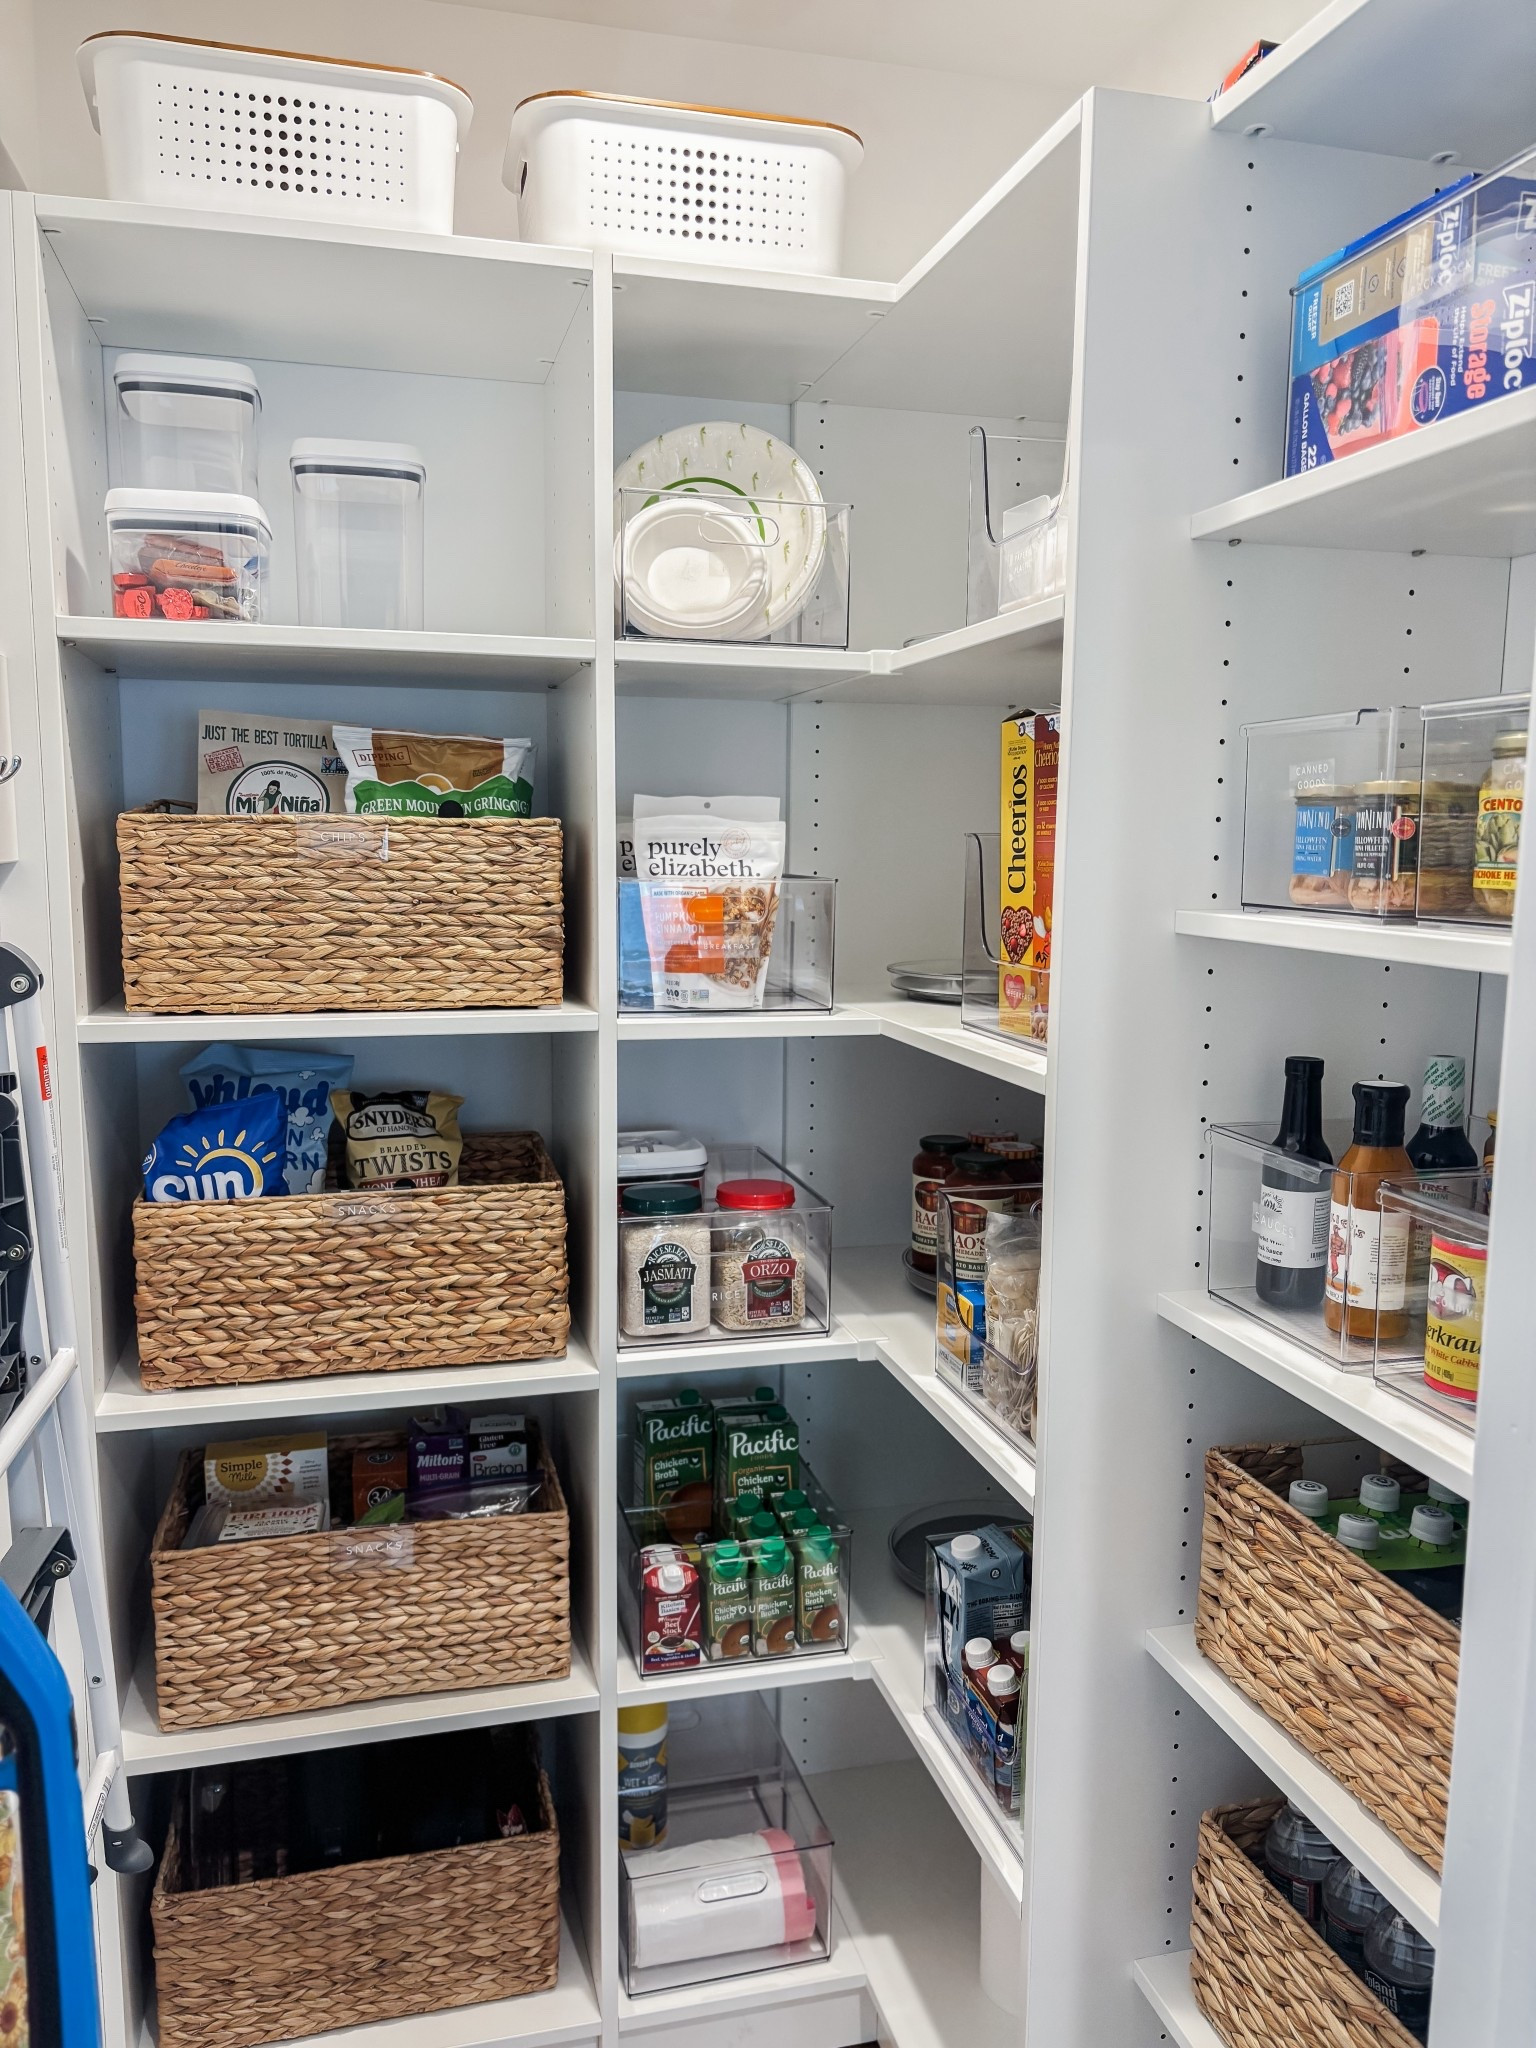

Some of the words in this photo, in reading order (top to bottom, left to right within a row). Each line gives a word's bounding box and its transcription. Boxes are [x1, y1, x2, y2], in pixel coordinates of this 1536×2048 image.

[1436, 204, 1460, 286] Ziploc
[1310, 291, 1319, 341] FREEZER
[1459, 306, 1467, 336] Helps
[1500, 287, 1531, 390] Ziploc
[1458, 337, 1467, 373] Extend
[1463, 299, 1496, 399] Storage
[1301, 392, 1310, 440] GALLON
[1307, 445, 1317, 469] 22
[202, 724, 227, 741] JUST
[231, 727, 250, 743] THE
[254, 729, 279, 745] BEST
[283, 732, 328, 750] TORTILLA
[358, 751, 405, 762] DIPPING
[1295, 763, 1329, 777] CANNED
[1297, 778, 1326, 790] GOODS
[235, 796, 257, 814] Mi
[280, 795, 320, 813] Niña
[360, 798, 403, 815] GREEN
[406, 799, 472, 815] MOUNN
[474, 796, 518, 812] GRINGO
[1483, 798, 1523, 812] CENTO
[1008, 764, 1028, 894] Cheerios
[320, 832, 366, 844] CHIPS
[648, 837, 722, 861] purely
[648, 858, 761, 877] elizabeth.
[655, 911, 696, 923] PUMPKIN
[657, 923, 705, 934] CINNAMON
[703, 942, 756, 950] BREAKFAST
[353, 1110, 434, 1130] SNYDER'S
[380, 1143, 427, 1154] BRAIDED
[354, 1150, 452, 1179] TWISTS
[337, 1203, 397, 1217] SNACKS
[1254, 1211, 1294, 1239] SAUCES
[915, 1235, 934, 1245] TOMATO
[955, 1234, 986, 1251] AO'S
[647, 1244, 689, 1264] RICESELECT
[643, 1267, 693, 1283] JASMATI
[750, 1262, 790, 1278] ORZO
[711, 1290, 741, 1302] RICE
[1434, 1298, 1485, 1323] CONDIME
[1430, 1347, 1449, 1362] White
[1450, 1355, 1480, 1371] Cabba
[645, 1414, 713, 1445] Pacific
[478, 1433, 504, 1443] Gluten
[479, 1441, 497, 1450] Free
[729, 1428, 799, 1459] Pacific
[220, 1459, 263, 1473] Simple
[416, 1453, 465, 1468] Milton's
[654, 1456, 689, 1471] Chicken
[228, 1471, 257, 1482] Mills
[419, 1472, 461, 1483] MULTI-GRAIN
[473, 1463, 525, 1477] Breton
[654, 1467, 679, 1481] Broth
[737, 1465, 765, 1475] Organic
[737, 1475, 774, 1487] Chicken
[345, 1540, 403, 1555] SNACKS
[801, 1562, 839, 1580] Pacific
[805, 1588, 833, 1598] Chicken
[660, 1601, 685, 1610] Kitchen
[761, 1599, 788, 1611] Chicken
[805, 1597, 825, 1606] Broth
[714, 1612, 735, 1622] Broth
[760, 1607, 780, 1618] Broth
[662, 1627, 683, 1635] Stock
